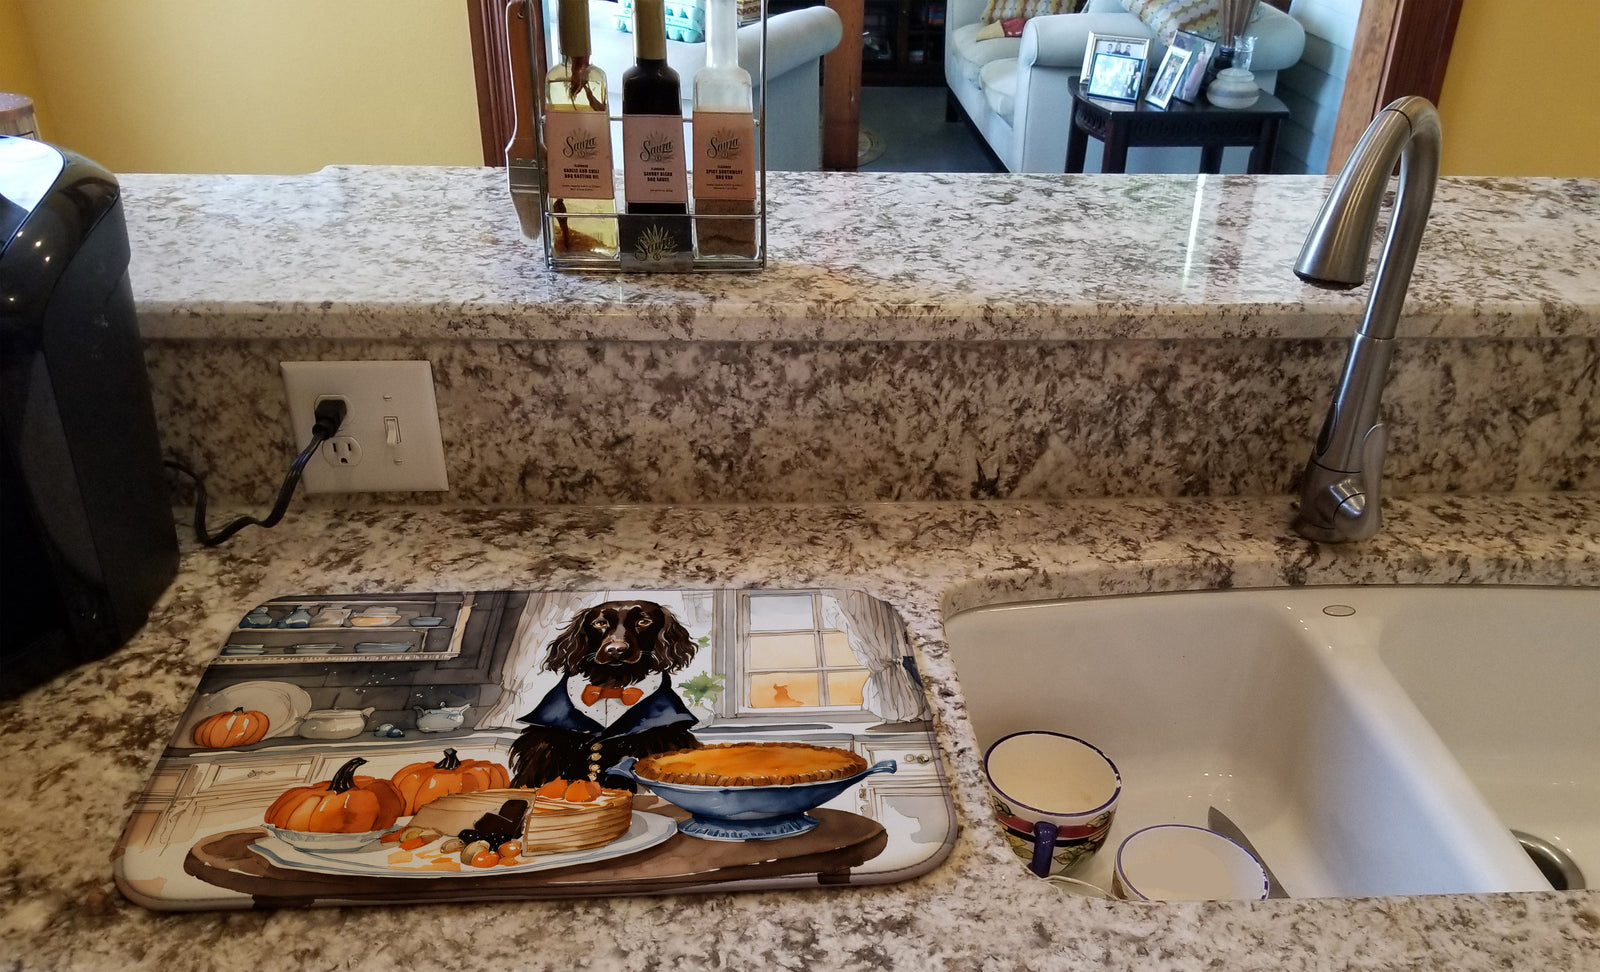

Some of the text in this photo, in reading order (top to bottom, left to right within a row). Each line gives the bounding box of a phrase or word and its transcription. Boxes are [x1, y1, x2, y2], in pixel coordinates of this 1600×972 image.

[562, 136, 597, 158] Sauza
[640, 140, 673, 161] Sauza
[707, 136, 740, 158] Sauza
